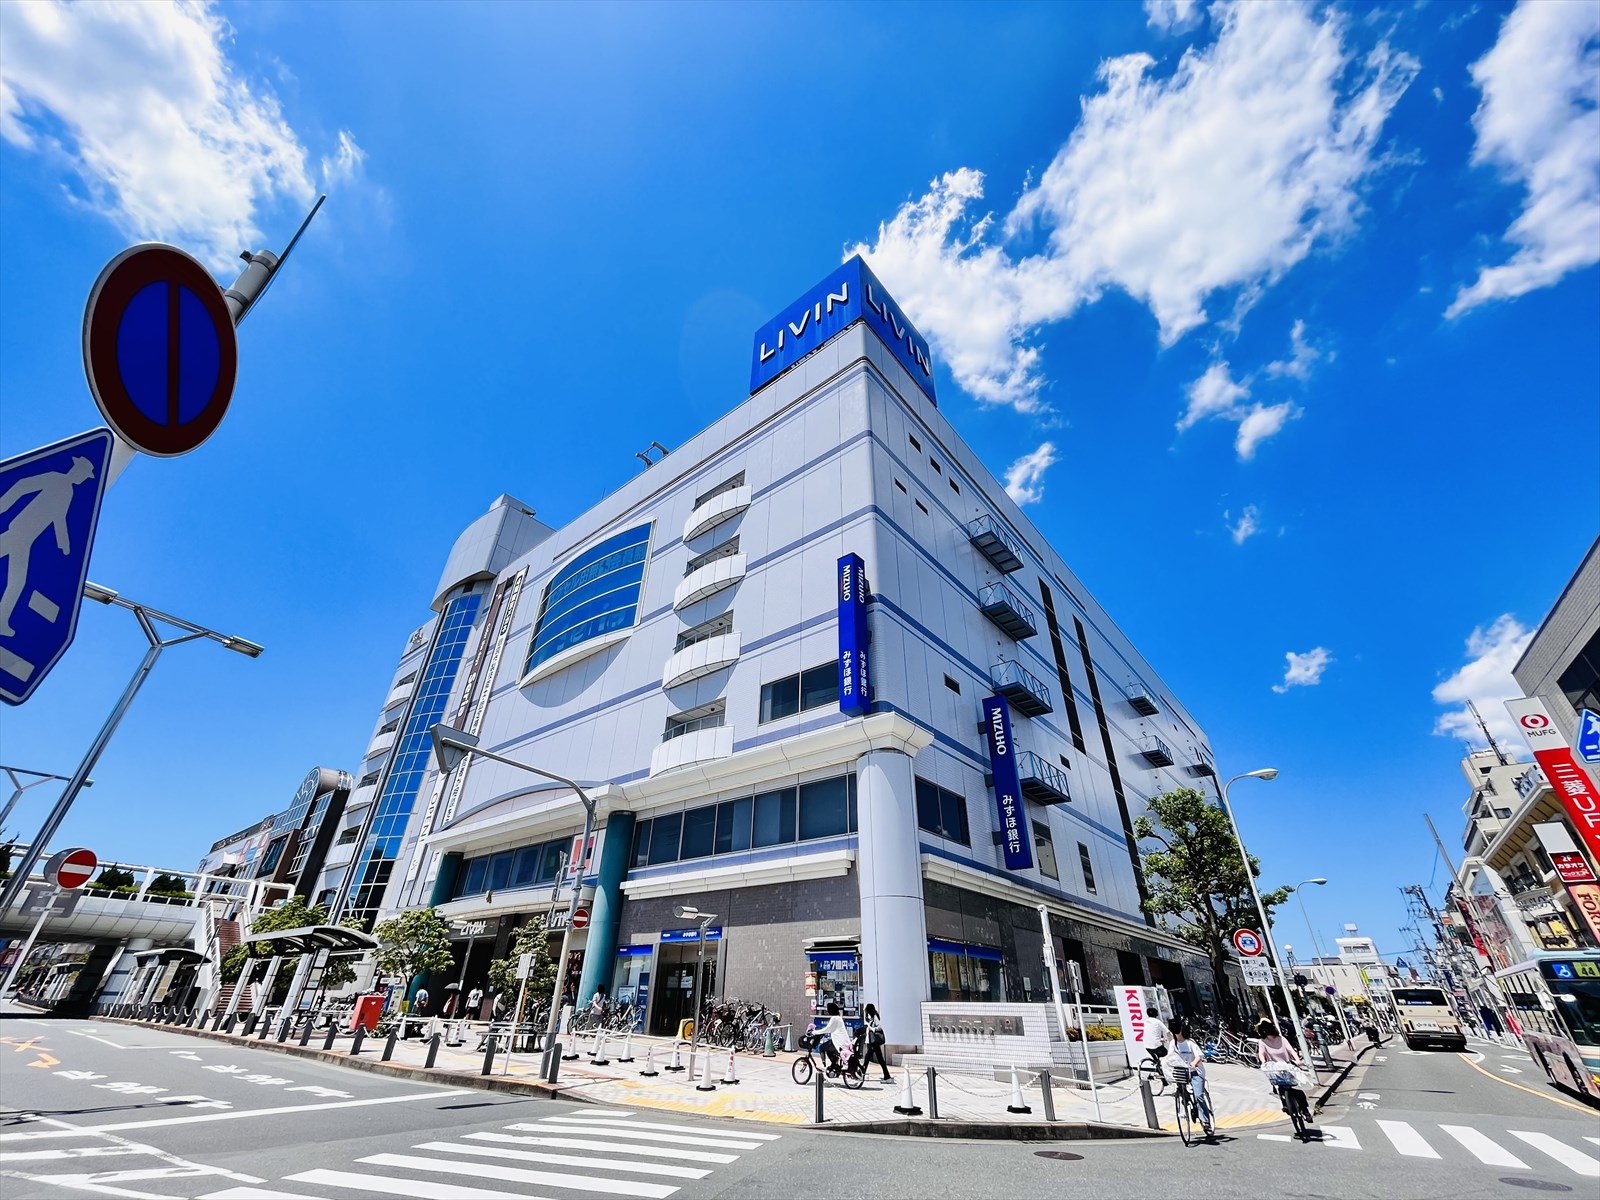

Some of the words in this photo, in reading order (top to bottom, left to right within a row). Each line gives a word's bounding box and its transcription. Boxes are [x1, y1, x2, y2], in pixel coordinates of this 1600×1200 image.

[759, 281, 849, 363] LIVIN
[865, 283, 930, 377] LIVIN
[842, 565, 851, 602] MIZUHO
[843, 650, 852, 697] みずほ銀行
[859, 650, 867, 697] みずほ銀行
[991, 707, 1007, 756] MIZUHO
[1526, 728, 1557, 738] MUFG
[1002, 794, 1021, 854] みずほ銀行
[1551, 762, 1600, 841] 三菱UF
[1125, 989, 1145, 1042] KIRIN
